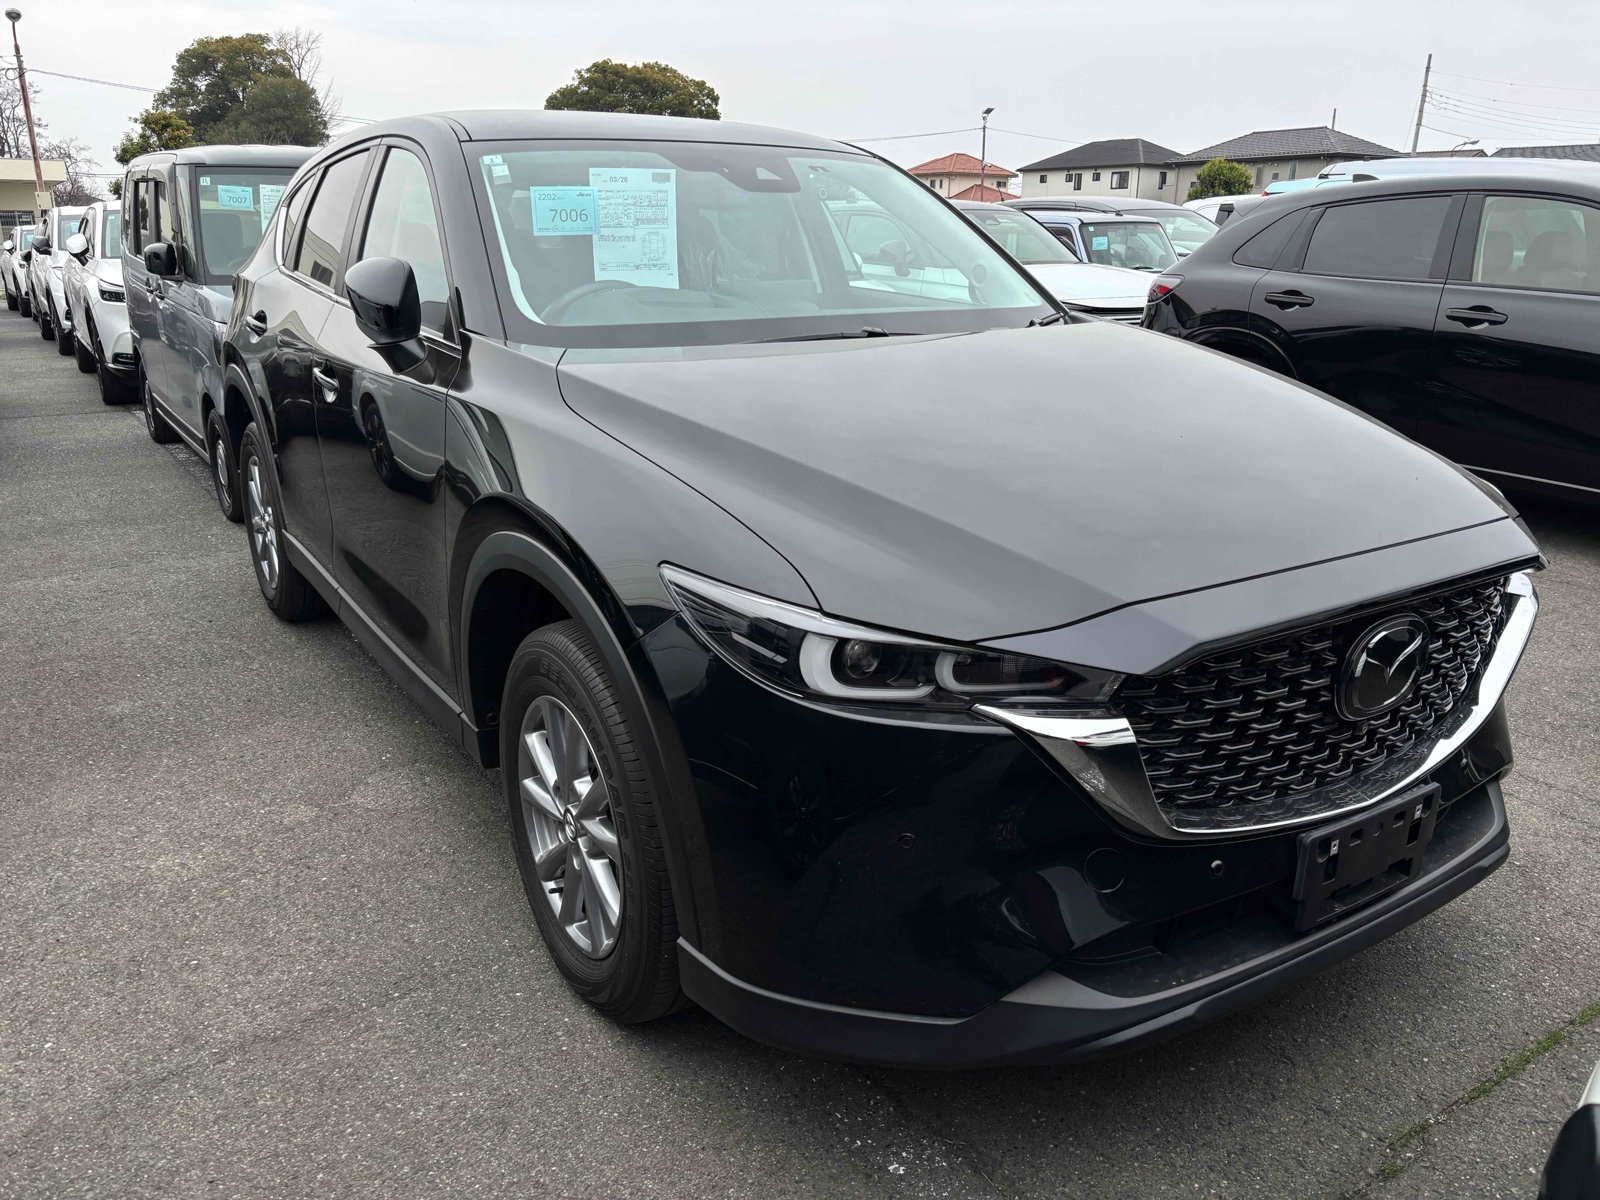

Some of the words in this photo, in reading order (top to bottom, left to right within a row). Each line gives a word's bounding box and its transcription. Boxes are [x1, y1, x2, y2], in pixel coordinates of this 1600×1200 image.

[227, 196, 247, 204] 7007
[537, 193, 557, 201] 2202
[549, 208, 589, 222] 7006
[538, 657, 629, 840] GEOLANDAR
